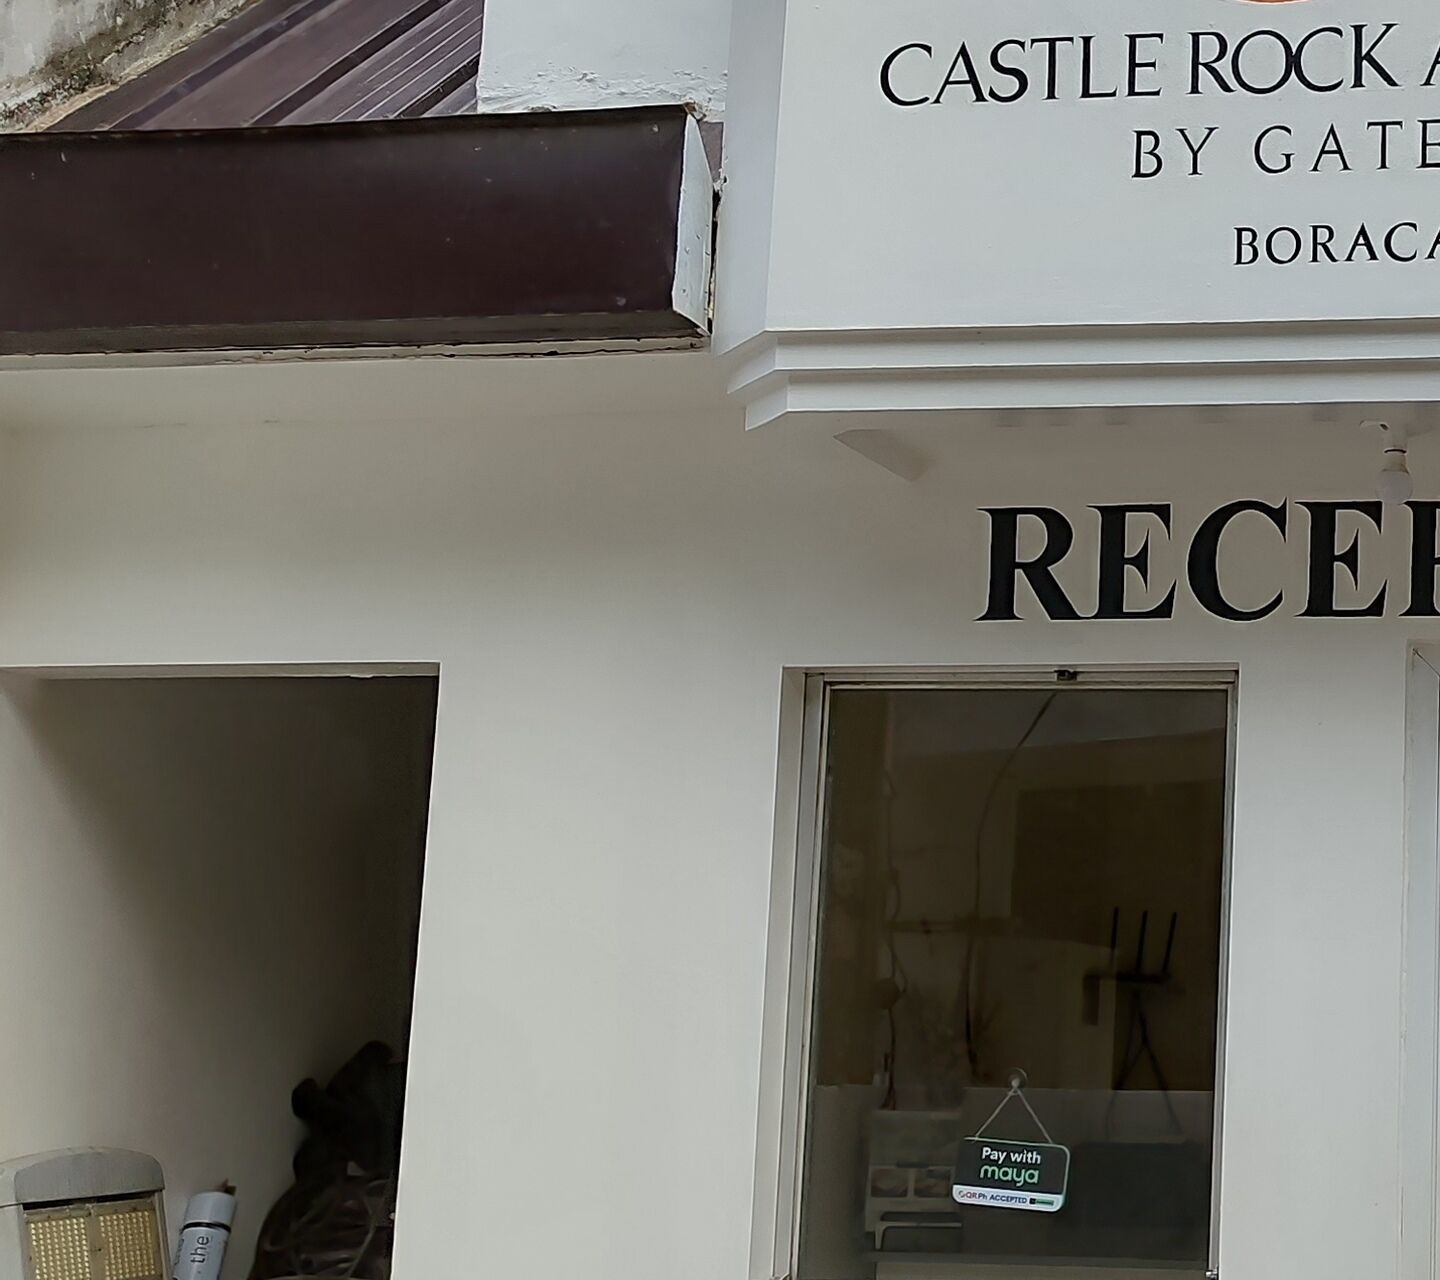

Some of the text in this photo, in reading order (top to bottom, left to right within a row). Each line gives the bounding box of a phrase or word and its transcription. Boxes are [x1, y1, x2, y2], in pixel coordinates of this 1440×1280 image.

[880, 32, 1164, 107] CASTLE
[1186, 24, 1402, 95] ROCK
[1131, 126, 1219, 179] BY
[982, 1146, 1041, 1164] Pay with
[980, 1165, 1039, 1187] maya
[989, 1194, 1028, 1204] ACCEPTED
[190, 1235, 210, 1264] the
